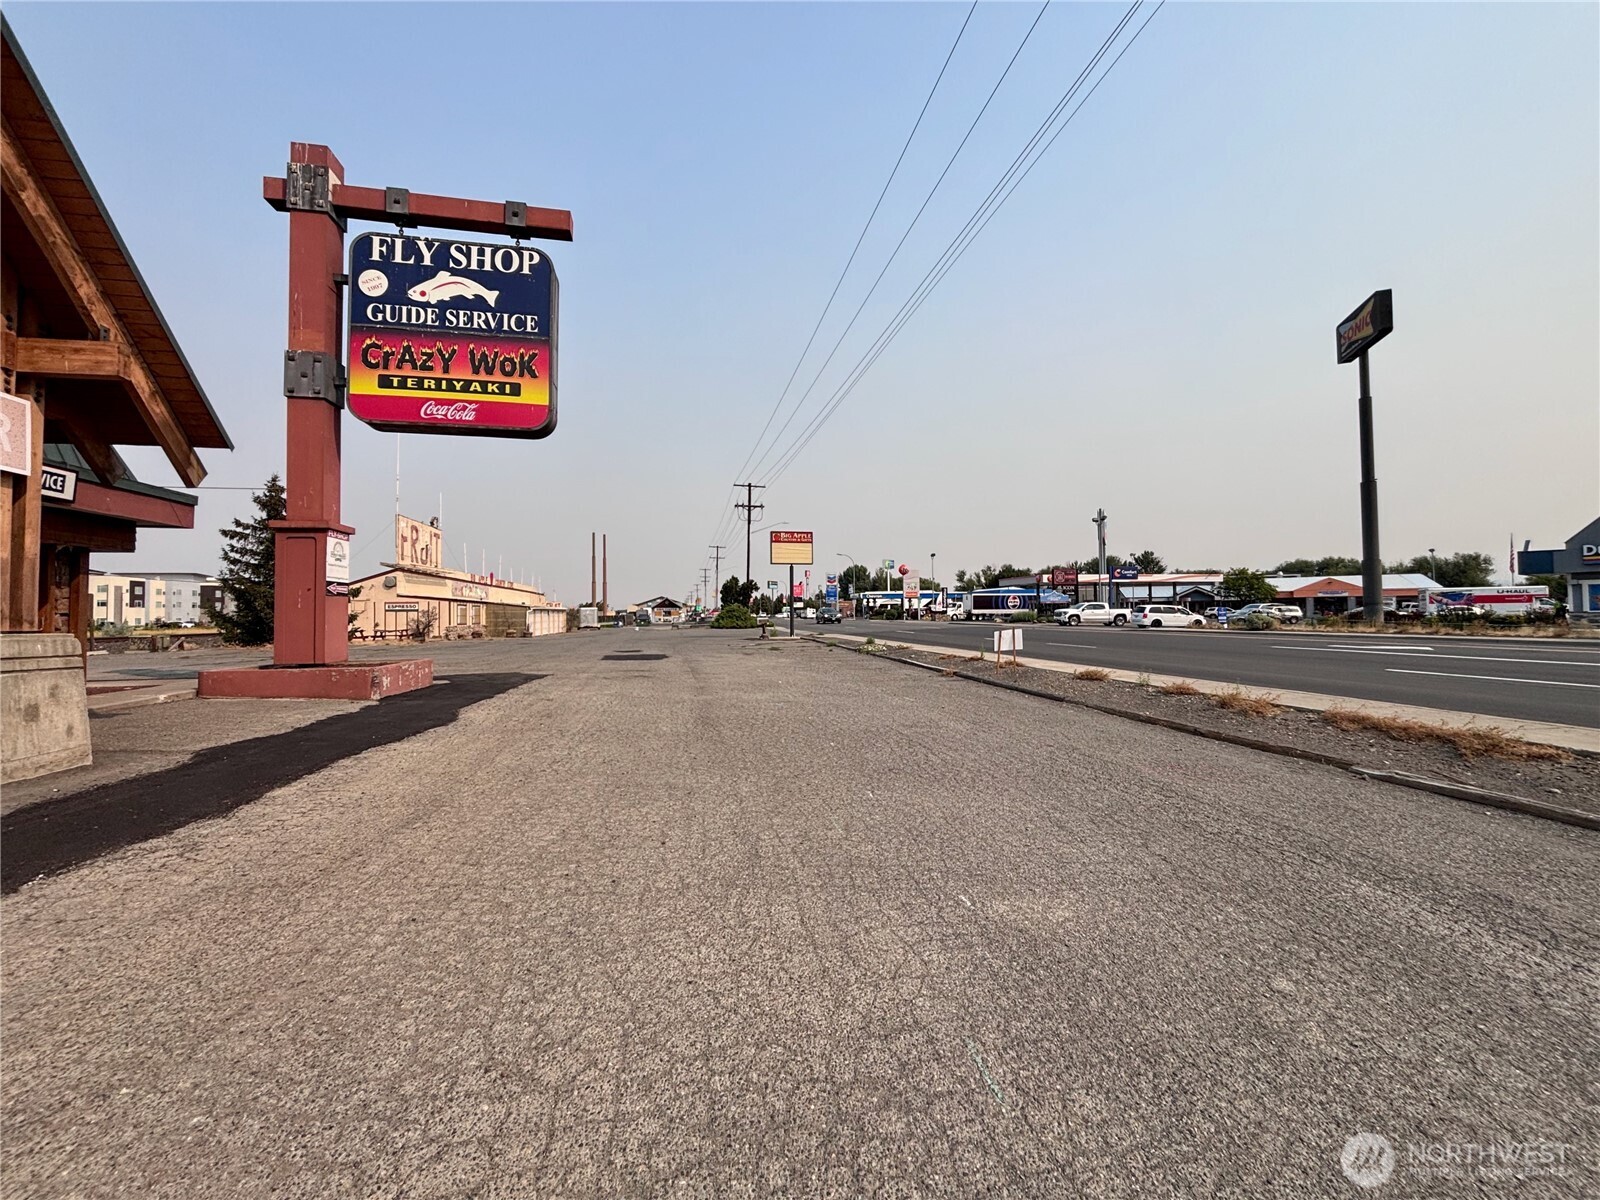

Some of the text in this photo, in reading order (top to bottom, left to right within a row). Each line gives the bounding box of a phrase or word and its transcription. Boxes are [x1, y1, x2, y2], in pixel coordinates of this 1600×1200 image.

[369, 235, 540, 275] FLY SHOP
[366, 303, 539, 333] GUIDE SERVICE
[1342, 311, 1372, 343] SONIC
[389, 377, 511, 394] TERIYAKI
[1582, 544, 1600, 556] D
